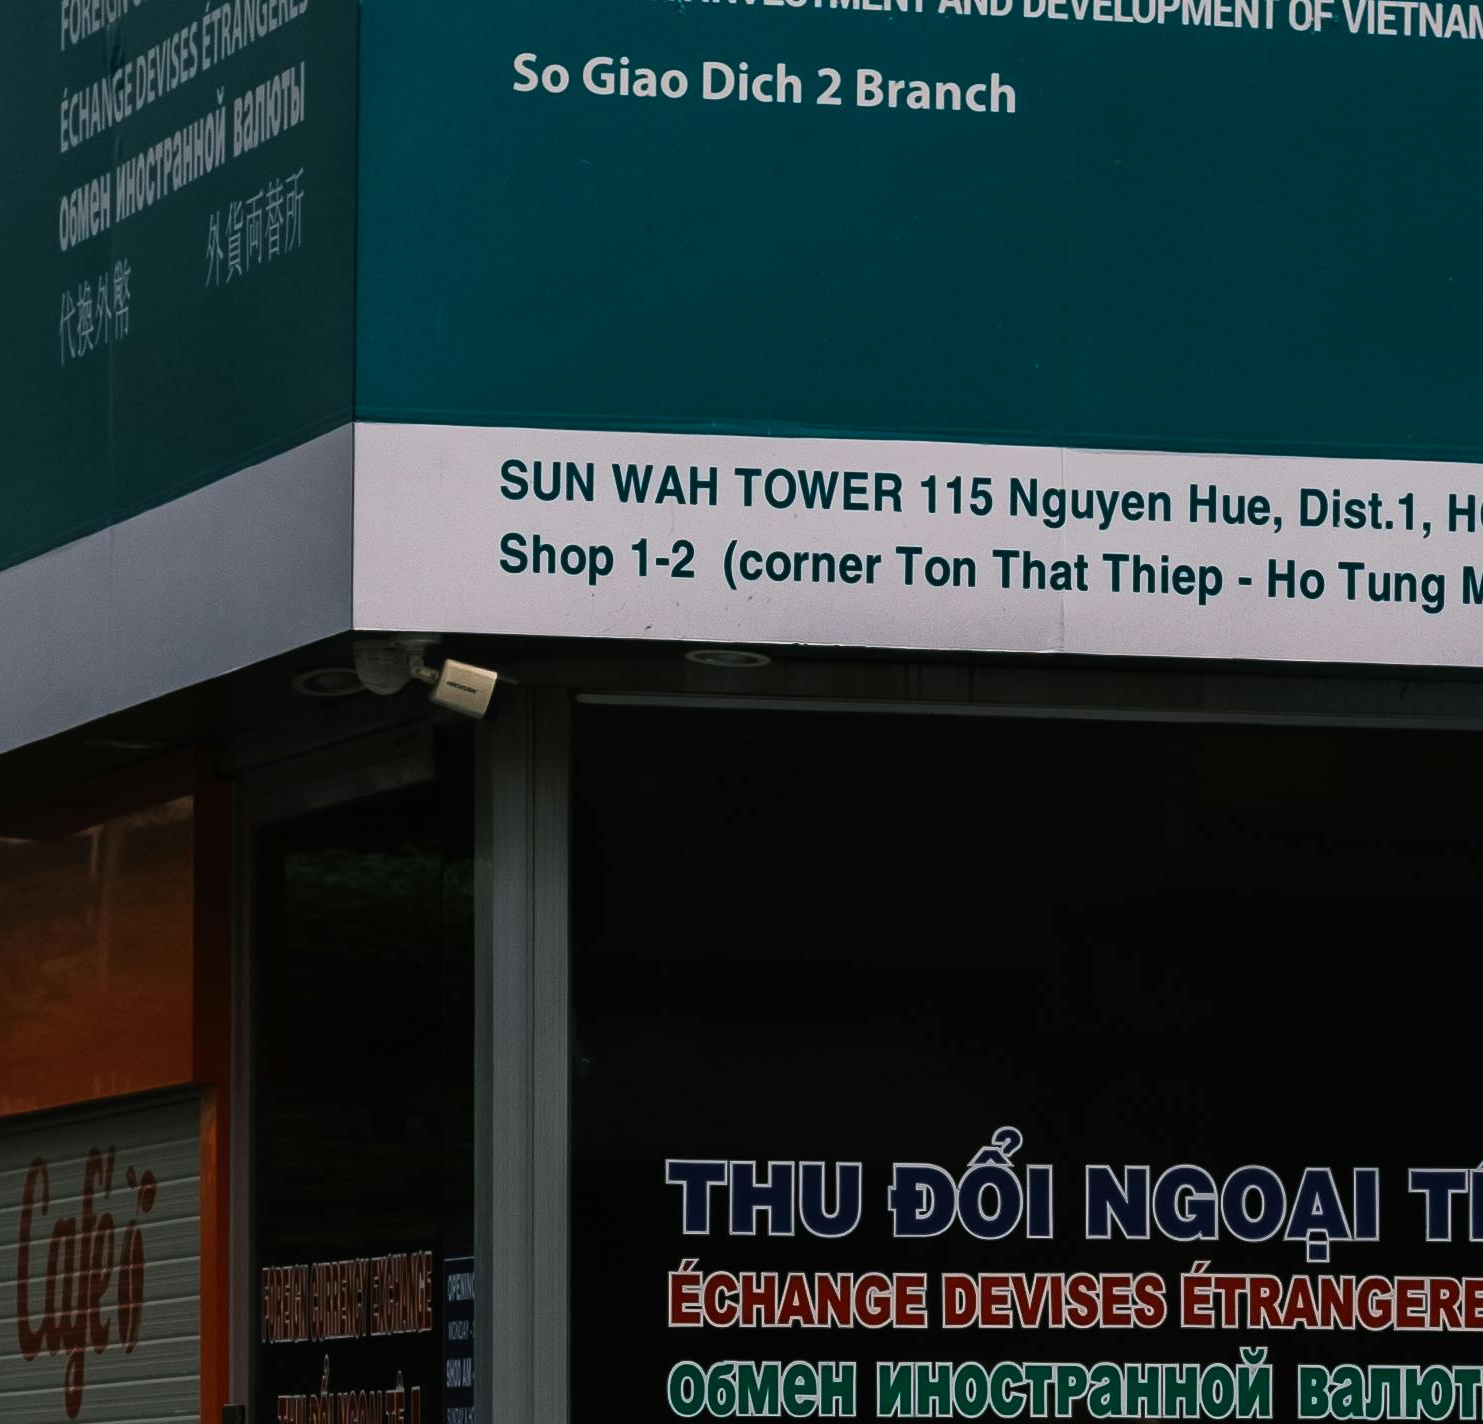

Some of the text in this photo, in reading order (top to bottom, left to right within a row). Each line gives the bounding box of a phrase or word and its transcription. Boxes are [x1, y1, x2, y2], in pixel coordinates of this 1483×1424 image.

[1289, 0, 1334, 32] OF
[60, 88, 133, 153] ÉCHANGE
[136, 21, 198, 111] DEVISES
[513, 52, 1016, 113] So Giao Dich 2 Branch
[500, 458, 594, 501] SUN
[612, 463, 718, 506] WAH
[734, 467, 903, 512] TOWER
[921, 474, 993, 516] 115
[1009, 477, 1171, 530] Nguyen
[1190, 484, 1283, 533] Hue,
[1300, 487, 1432, 539] Dist.1,
[500, 532, 614, 586] Shop
[631, 537, 695, 578] 1-2
[724, 540, 881, 590] (corner
[896, 545, 976, 588] Ton
[992, 549, 1089, 592] That
[1102, 553, 1223, 606] Thiep
[1238, 577, 1252, 586] -
[1268, 559, 1325, 600] Ho
[1338, 561, 1447, 614] Tung
[665, 1158, 863, 1239] THU
[888, 1126, 1054, 1240] ĐỔI
[1085, 1164, 1380, 1263] NGOẠI
[261, 1250, 433, 1344] FOREIGN CURRENCY EXCHANGE
[668, 1259, 928, 1329] ÉCHANGE
[942, 1272, 1167, 1330] DEVISES
